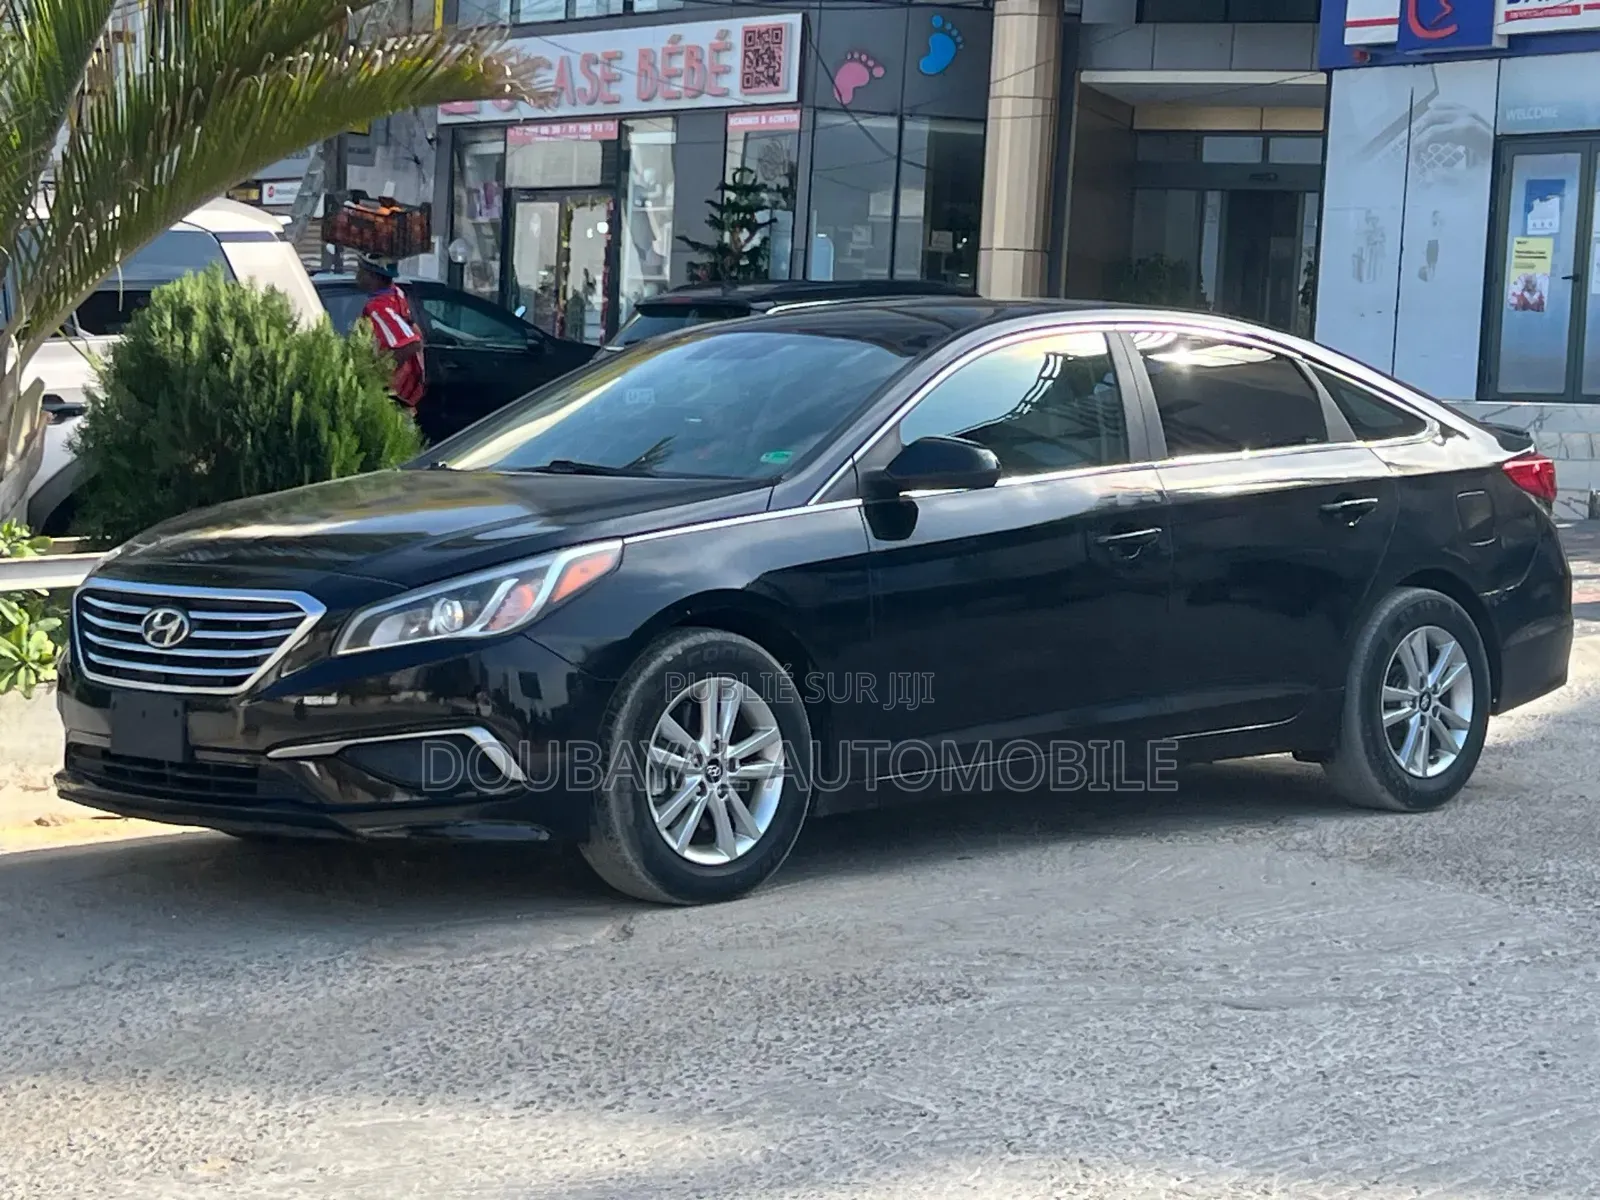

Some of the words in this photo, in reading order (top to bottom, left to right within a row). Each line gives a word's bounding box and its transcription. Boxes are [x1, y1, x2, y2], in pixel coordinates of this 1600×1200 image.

[550, 50, 623, 107] ASE
[636, 29, 733, 102] BÉBÉ
[1505, 106, 1559, 120] WELCOME
